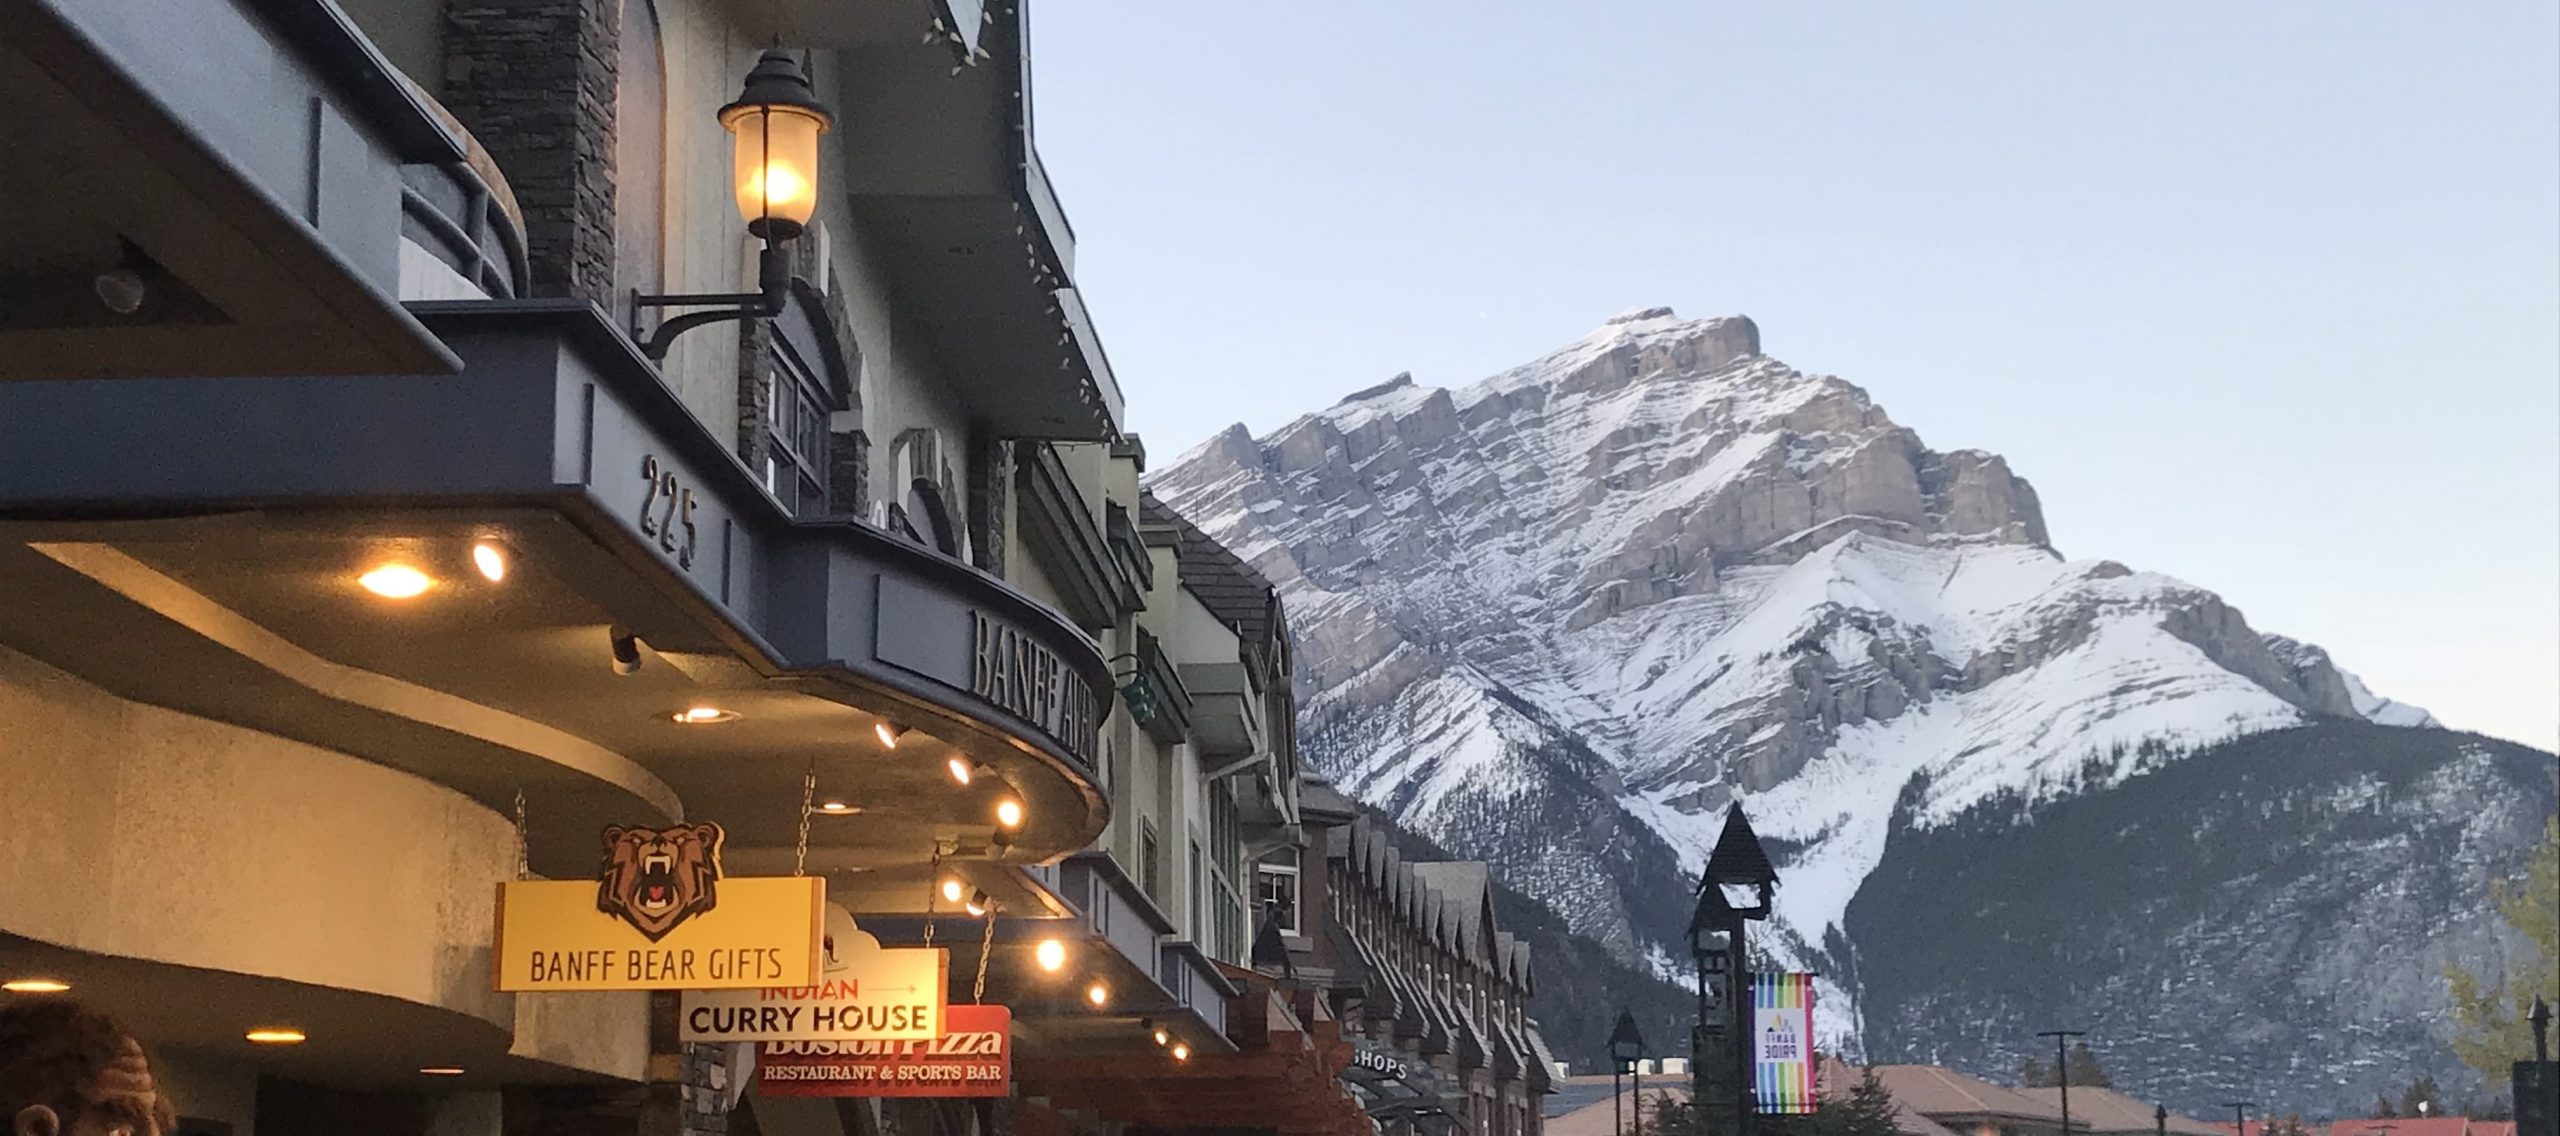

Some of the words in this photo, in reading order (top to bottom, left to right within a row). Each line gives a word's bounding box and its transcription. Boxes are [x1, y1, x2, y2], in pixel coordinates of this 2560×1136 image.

[641, 454, 697, 572] 225
[969, 608, 1060, 734] BANFF
[530, 950, 616, 982] BANFF
[627, 949, 696, 981] BEAR
[709, 948, 783, 979] GIFTS
[760, 979, 859, 1001] INDIAN
[689, 1006, 802, 1034] CURRY
[813, 1005, 928, 1032] HOUSE
[763, 1065, 877, 1080] RESTAURANT
[879, 1065, 894, 1080] &
[897, 1065, 962, 1080] SPORTS
[966, 1065, 1002, 1080] BAR
